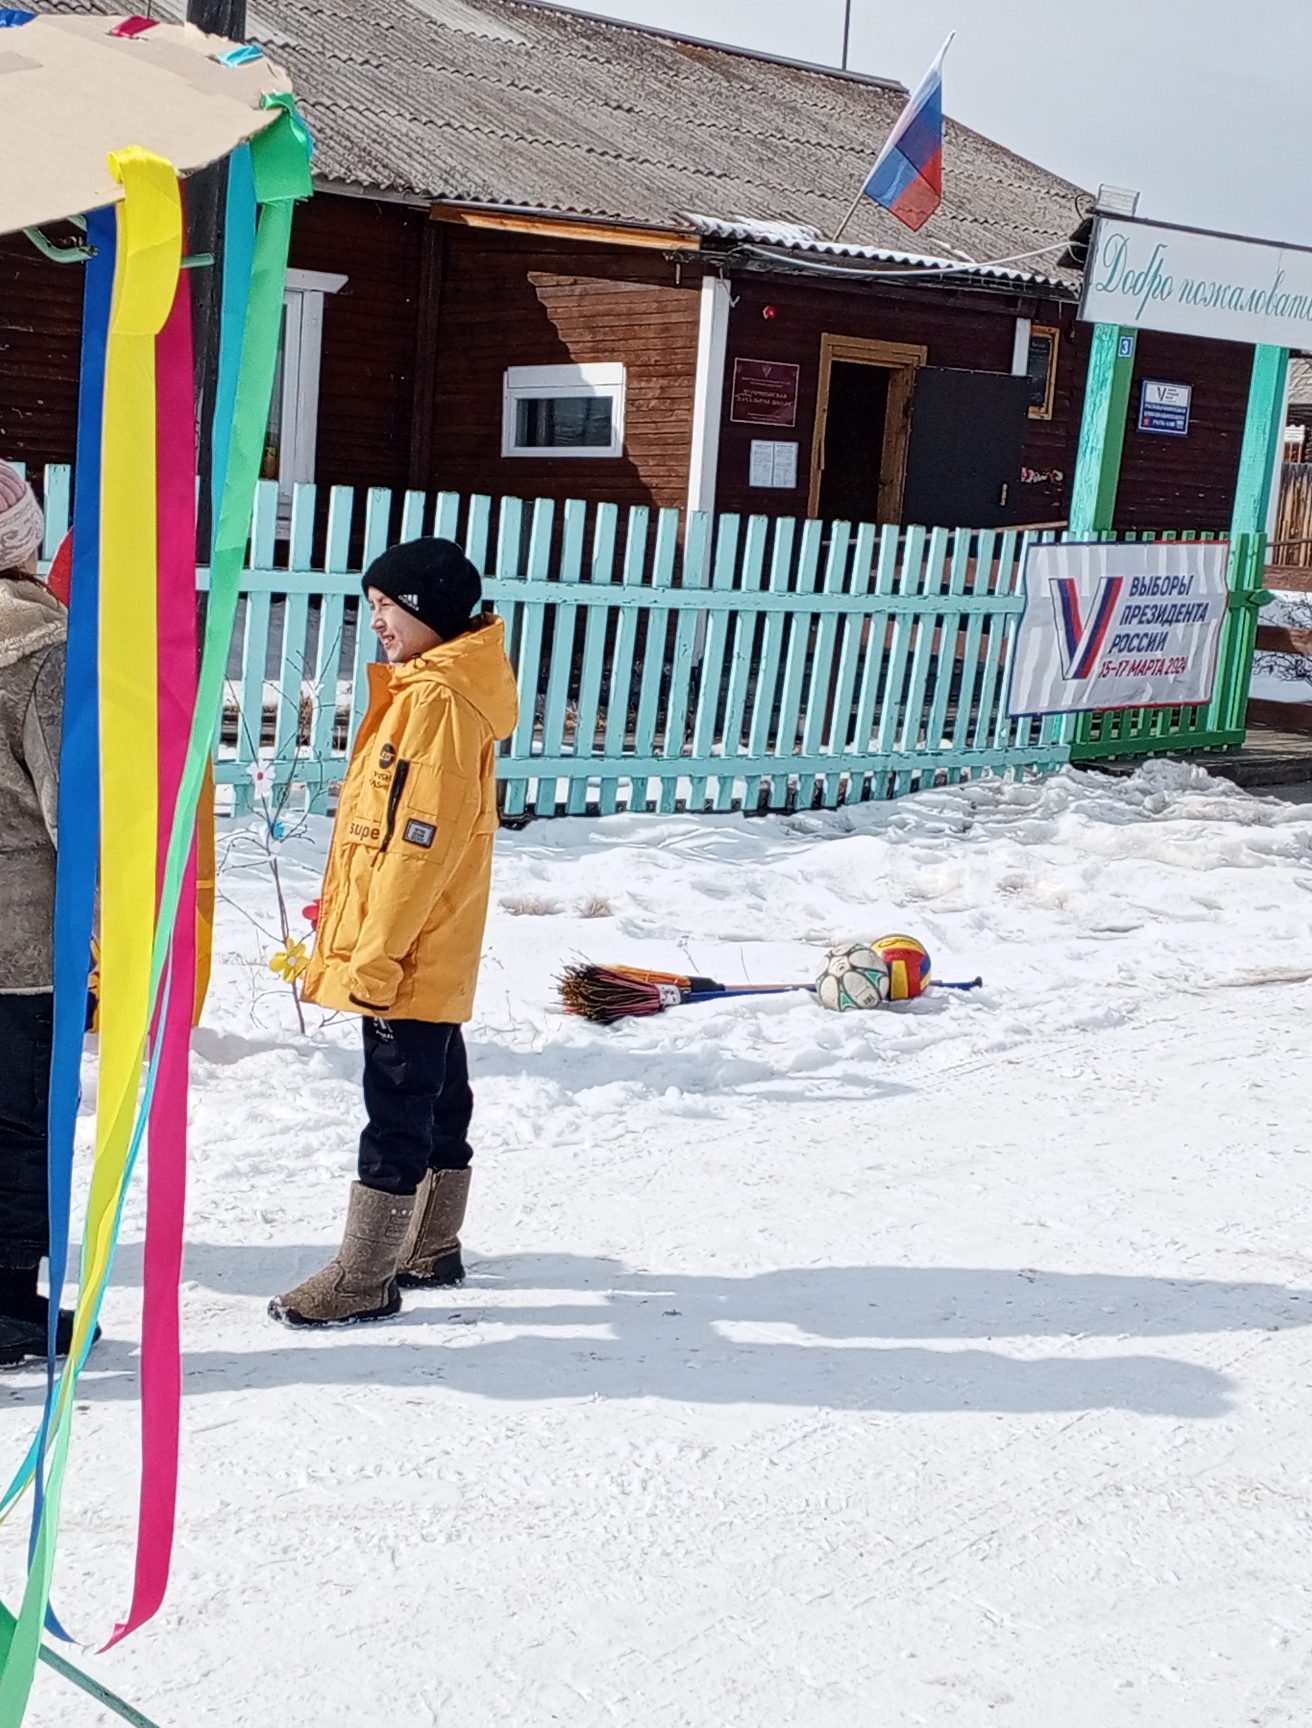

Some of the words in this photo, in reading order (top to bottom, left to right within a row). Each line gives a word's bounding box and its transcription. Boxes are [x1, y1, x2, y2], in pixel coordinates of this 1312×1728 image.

[1096, 233, 1173, 320] Добро
[1129, 575, 1194, 597] ВЫБОРЫ
[1119, 602, 1209, 627] ПРЕЗИДЕНТА
[1108, 631, 1169, 654] РОССИИ
[1127, 658, 1166, 677] МАРТА
